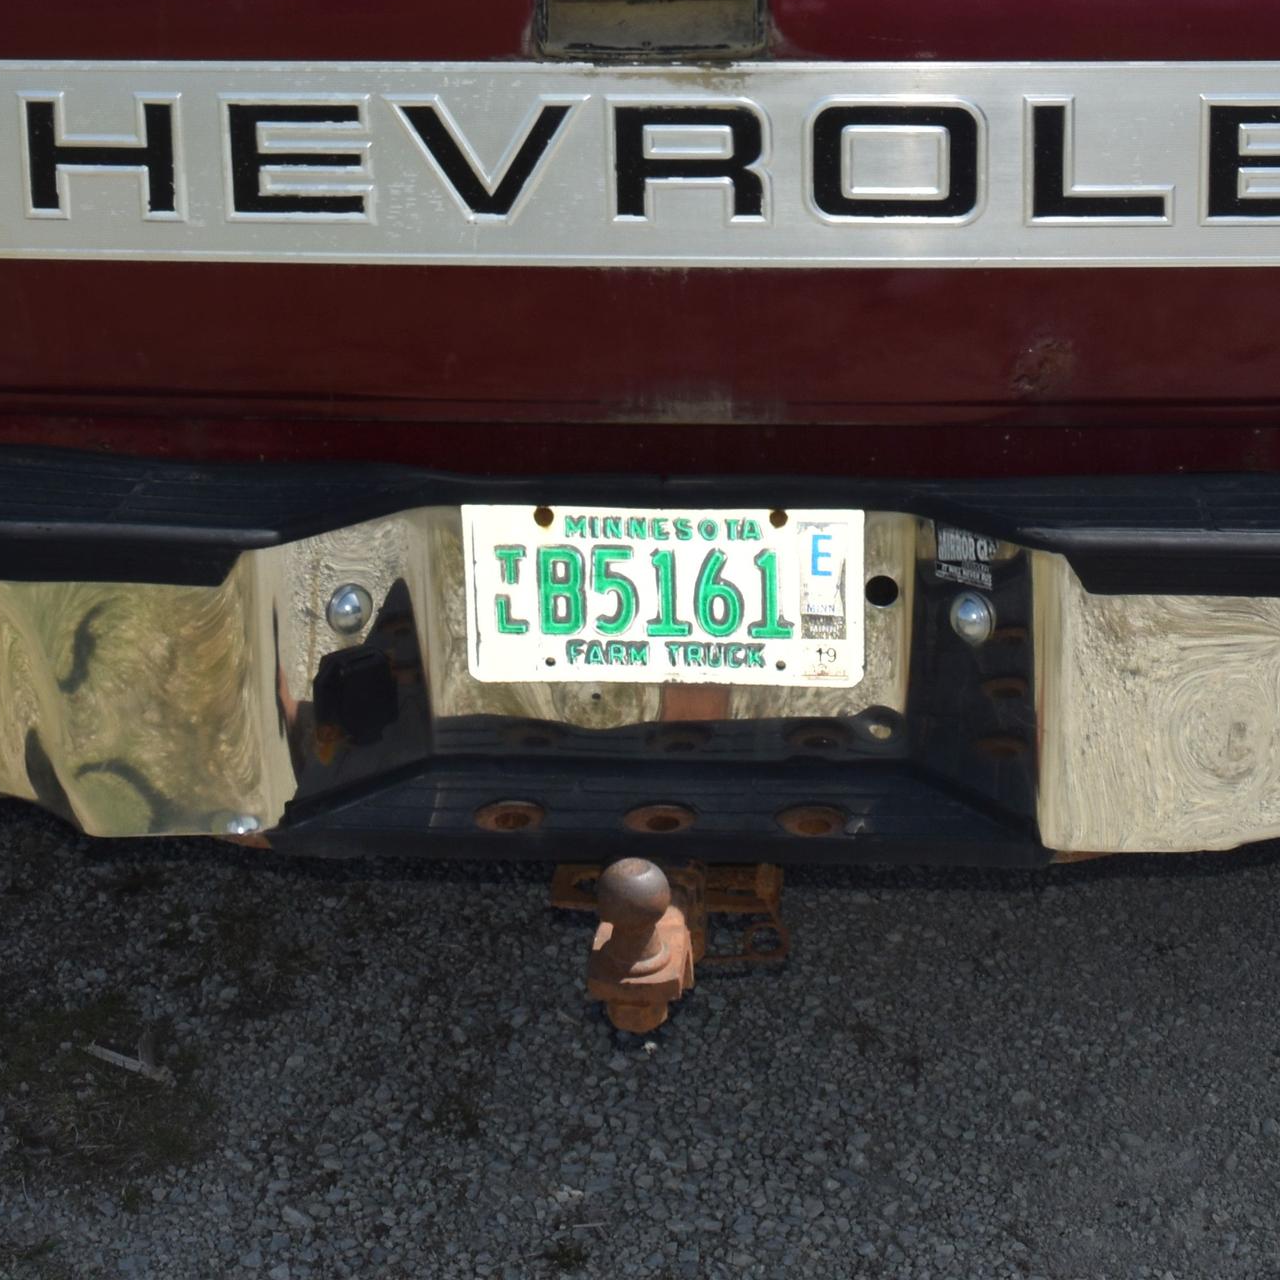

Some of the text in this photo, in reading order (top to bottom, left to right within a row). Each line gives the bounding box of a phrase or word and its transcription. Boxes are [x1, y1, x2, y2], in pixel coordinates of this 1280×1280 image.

[564, 514, 762, 541] MINNESOTA
[811, 534, 833, 576] E
[566, 639, 766, 668] FARM TRUCK
